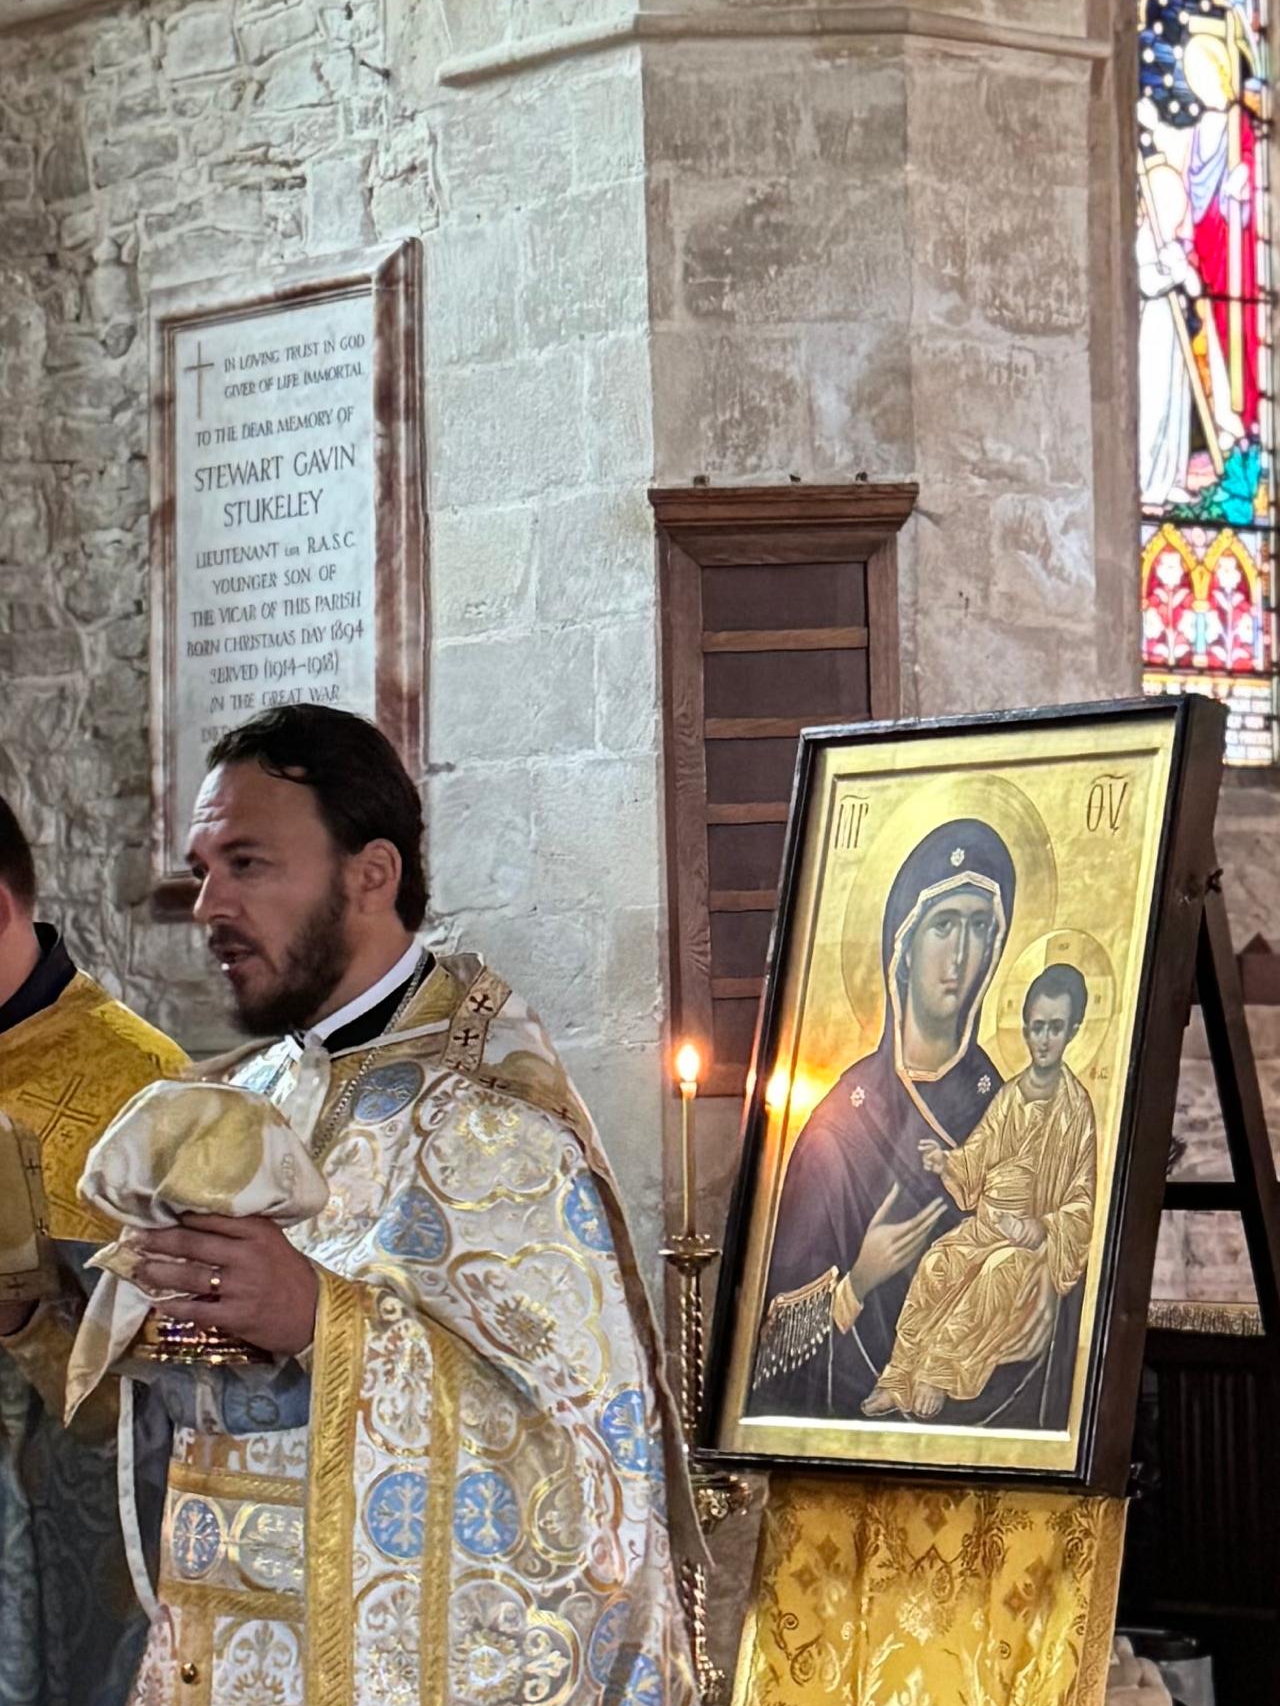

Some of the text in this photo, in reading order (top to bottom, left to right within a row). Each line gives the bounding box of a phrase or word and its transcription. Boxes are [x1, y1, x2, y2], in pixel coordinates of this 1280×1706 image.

[224, 334, 365, 373] IN LOVING TRUST IN GOD
[224, 361, 365, 399] GIVER OF LIFE IMMORTAL
[196, 406, 355, 447] TO THE DEAR MEMORY OF
[194, 443, 356, 493] STEWART GAVIN
[223, 488, 323, 528] STUKELEY
[195, 542, 280, 569] LIEUTENANT
[212, 563, 336, 595] YOUNGER SON OF
[189, 590, 362, 629] THE VICAR OF THIS PARISH
[187, 618, 365, 658] BORN CHRISTMAS DAY 1894
[210, 663, 259, 685] SERVED
[209, 683, 341, 714] IN THE GREAT WAR
